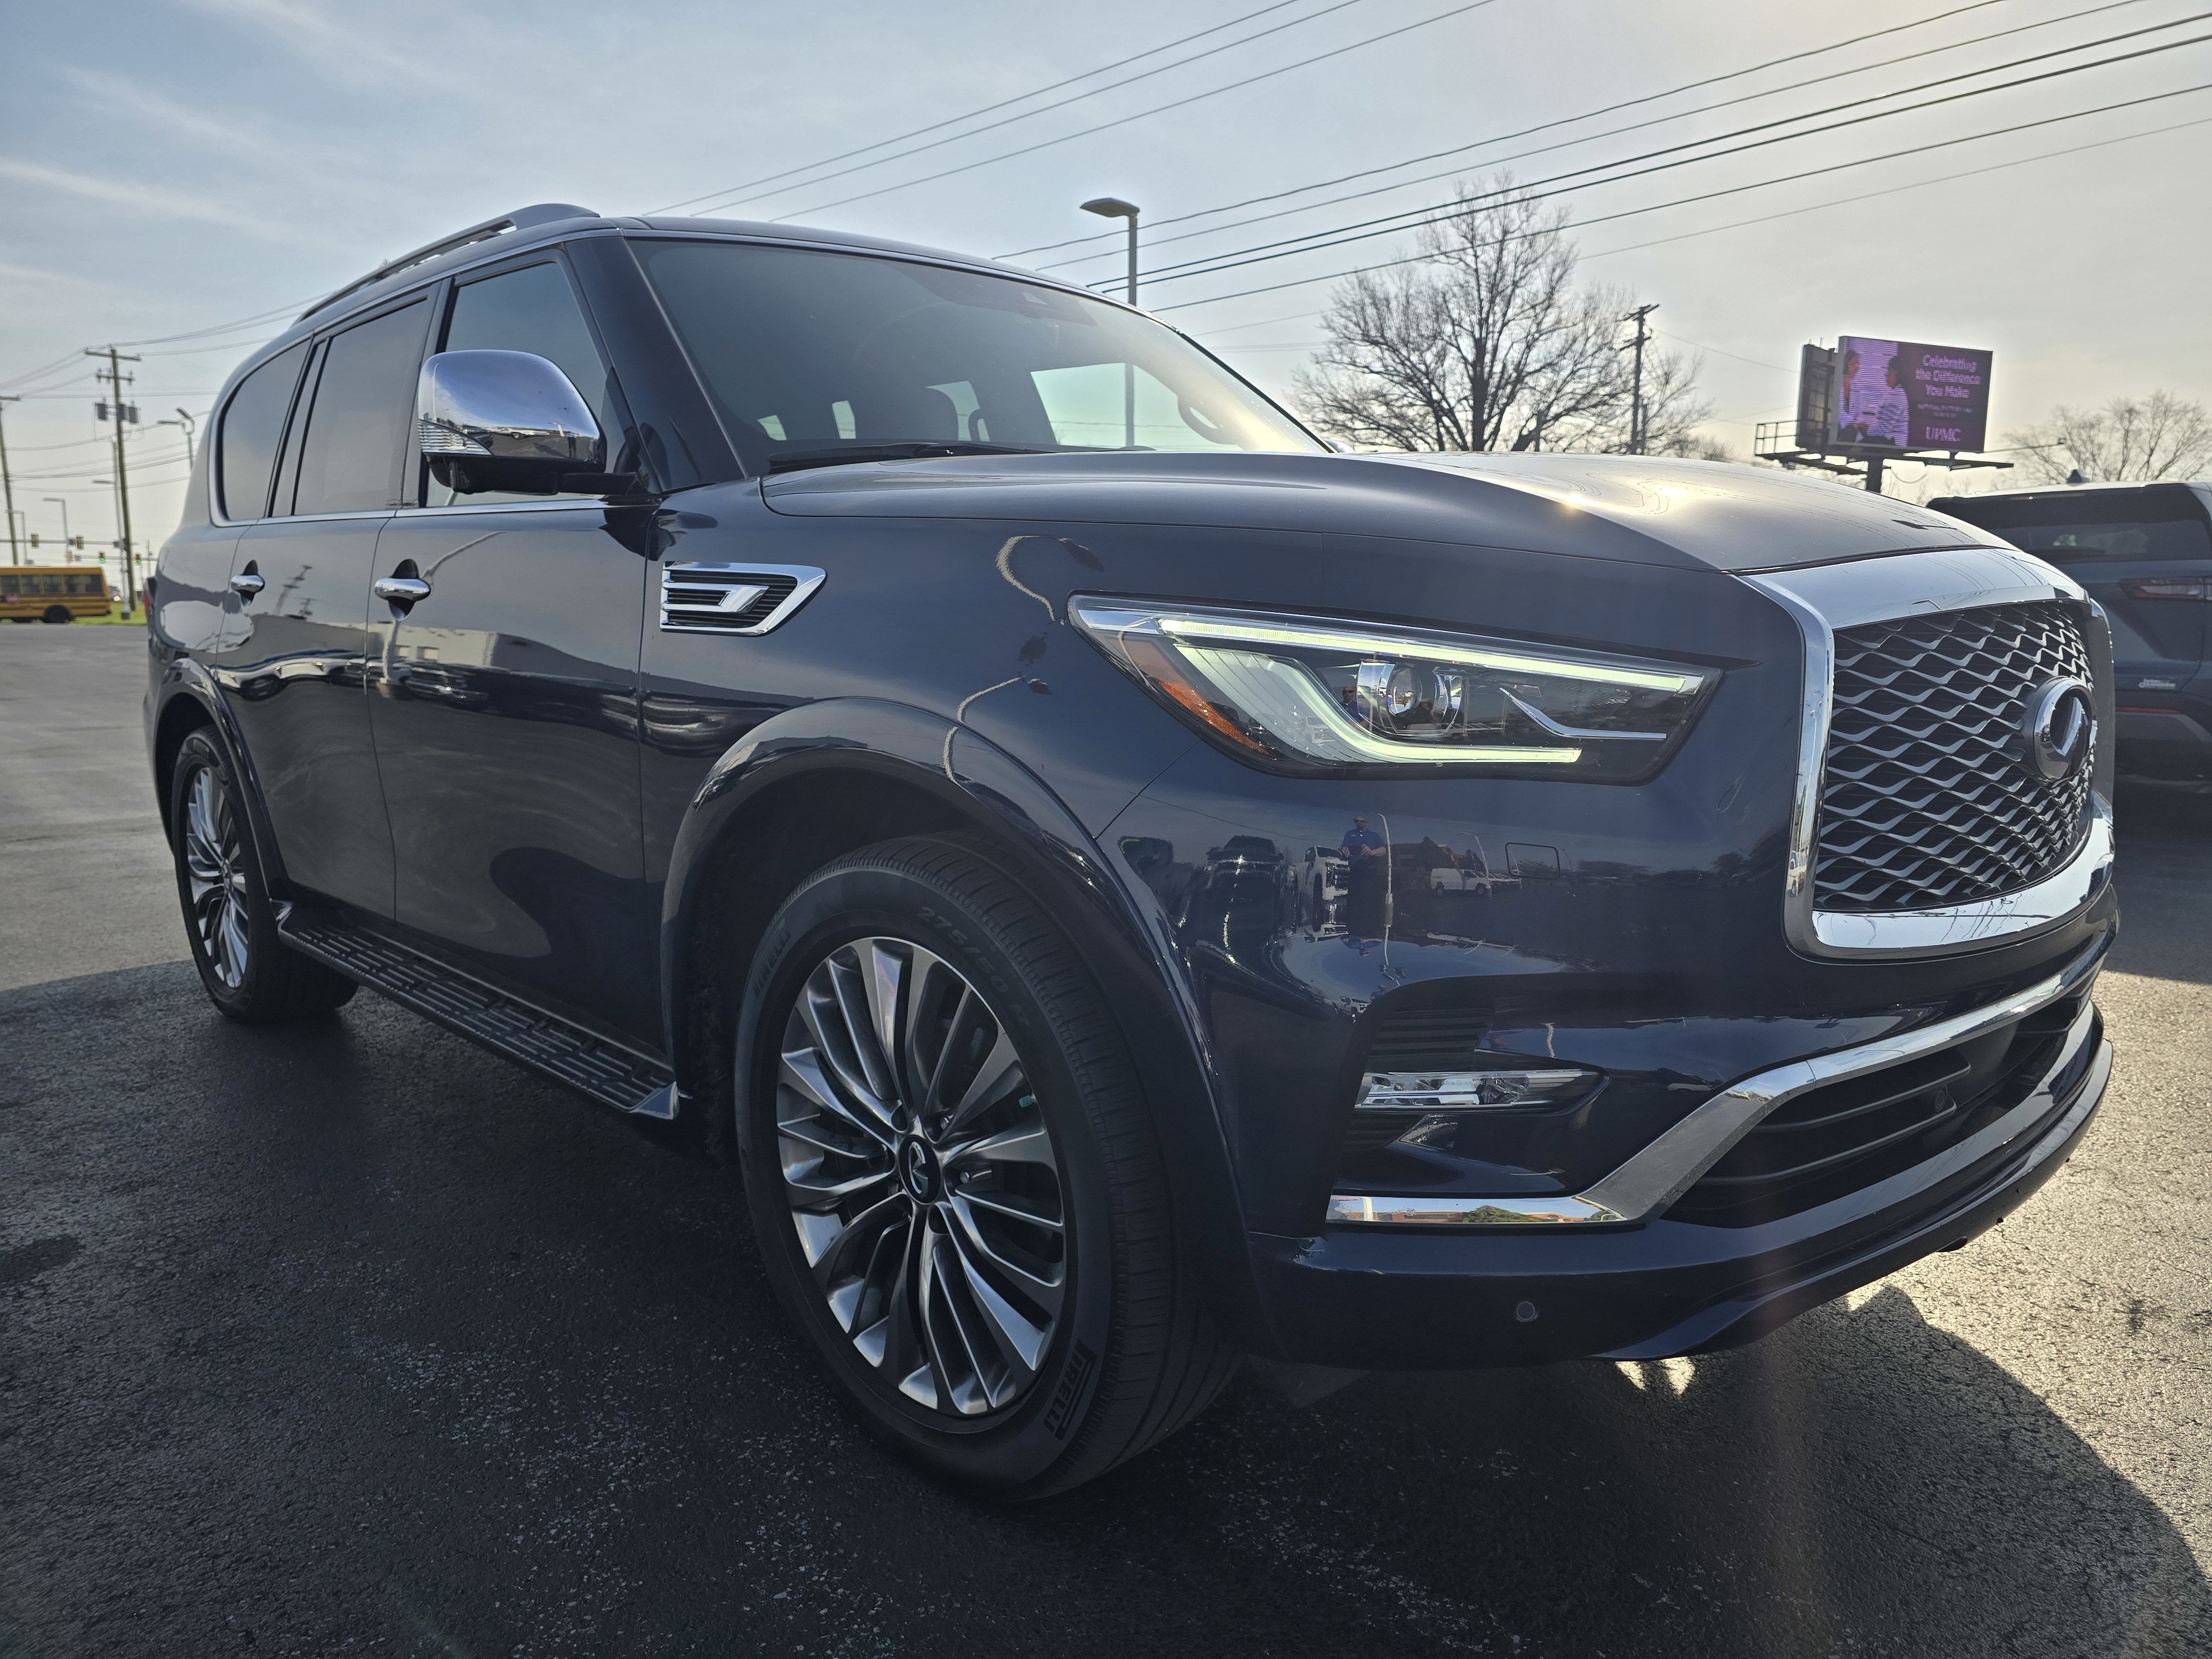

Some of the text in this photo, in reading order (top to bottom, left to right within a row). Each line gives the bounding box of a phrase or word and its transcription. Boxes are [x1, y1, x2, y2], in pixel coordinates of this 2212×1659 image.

[1923, 354, 1977, 373] Celebrating
[1916, 368, 1981, 384] the Difference
[1925, 384, 1970, 398] You Make
[1926, 426, 1961, 441] UPMC
[916, 906, 1008, 993] 275/50
[1043, 1338, 1098, 1441] PIRELLI
